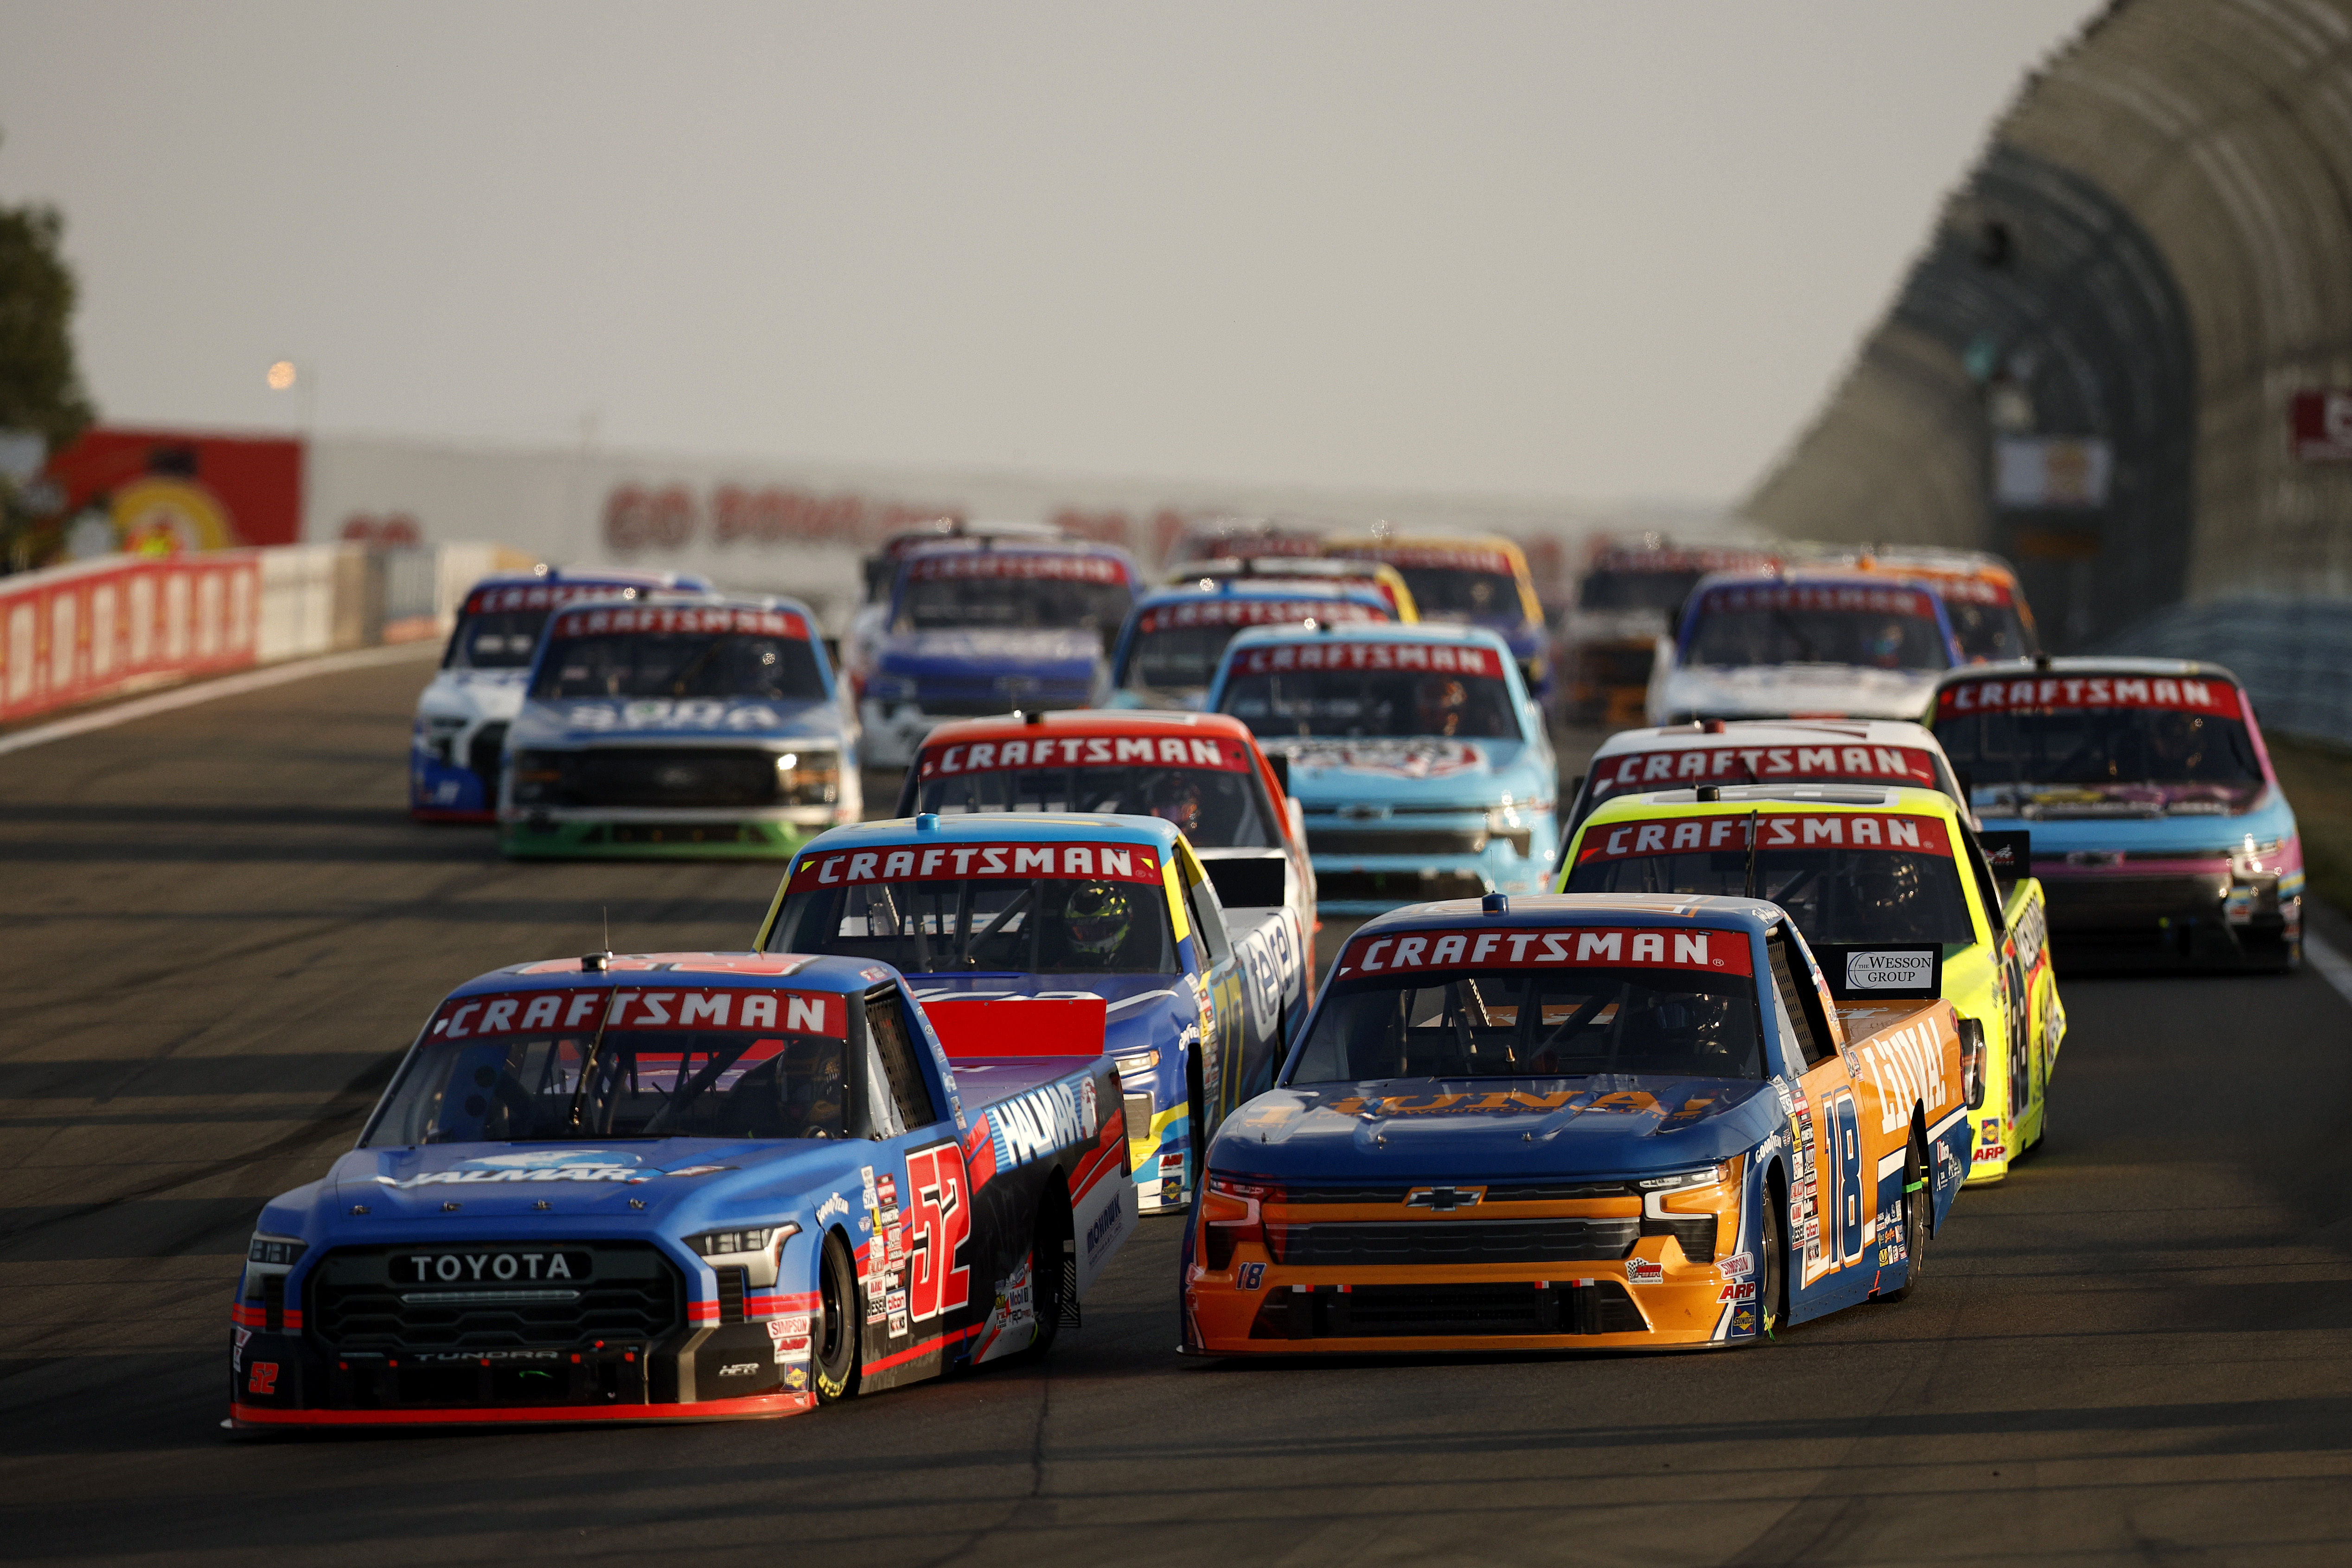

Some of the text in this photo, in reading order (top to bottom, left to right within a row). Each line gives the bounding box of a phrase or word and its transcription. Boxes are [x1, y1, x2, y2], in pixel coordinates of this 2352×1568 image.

[1249, 644, 1485, 672] CRAFTSMAN
[1954, 678, 2213, 710] CRAFTSMAN
[940, 738, 1223, 773] CRAFTSMAN
[1616, 747, 1910, 784] CRAFTSMAN
[1605, 818, 1920, 855] CRAFTSMAN
[817, 847, 1132, 883] CRAFTSMAN
[1361, 932, 1707, 971] CRAFTSMAN
[1869, 956, 1932, 968] WESSON
[1868, 972, 1915, 982] GROUP
[446, 992, 826, 1039] CRAFTSMAN
[992, 1083, 1082, 1165] HALMAR
[1755, 1130, 1782, 1164] GOODYEAR
[1973, 1146, 2005, 1160] ARP
[1821, 1085, 1865, 1274] 18
[906, 1141, 971, 1323] 52
[1806, 1222, 1818, 1239] tilton
[411, 1253, 571, 1282] TOYOTA
[1236, 1261, 1267, 1290] 18
[1720, 1255, 1749, 1276] SIMPSON
[1719, 1282, 1755, 1299] ARP
[771, 1318, 807, 1336] SIMPSON
[1733, 1315, 1755, 1326] SUNOCO
[414, 1350, 558, 1361] TUNDRA
[249, 1362, 279, 1395] 52
